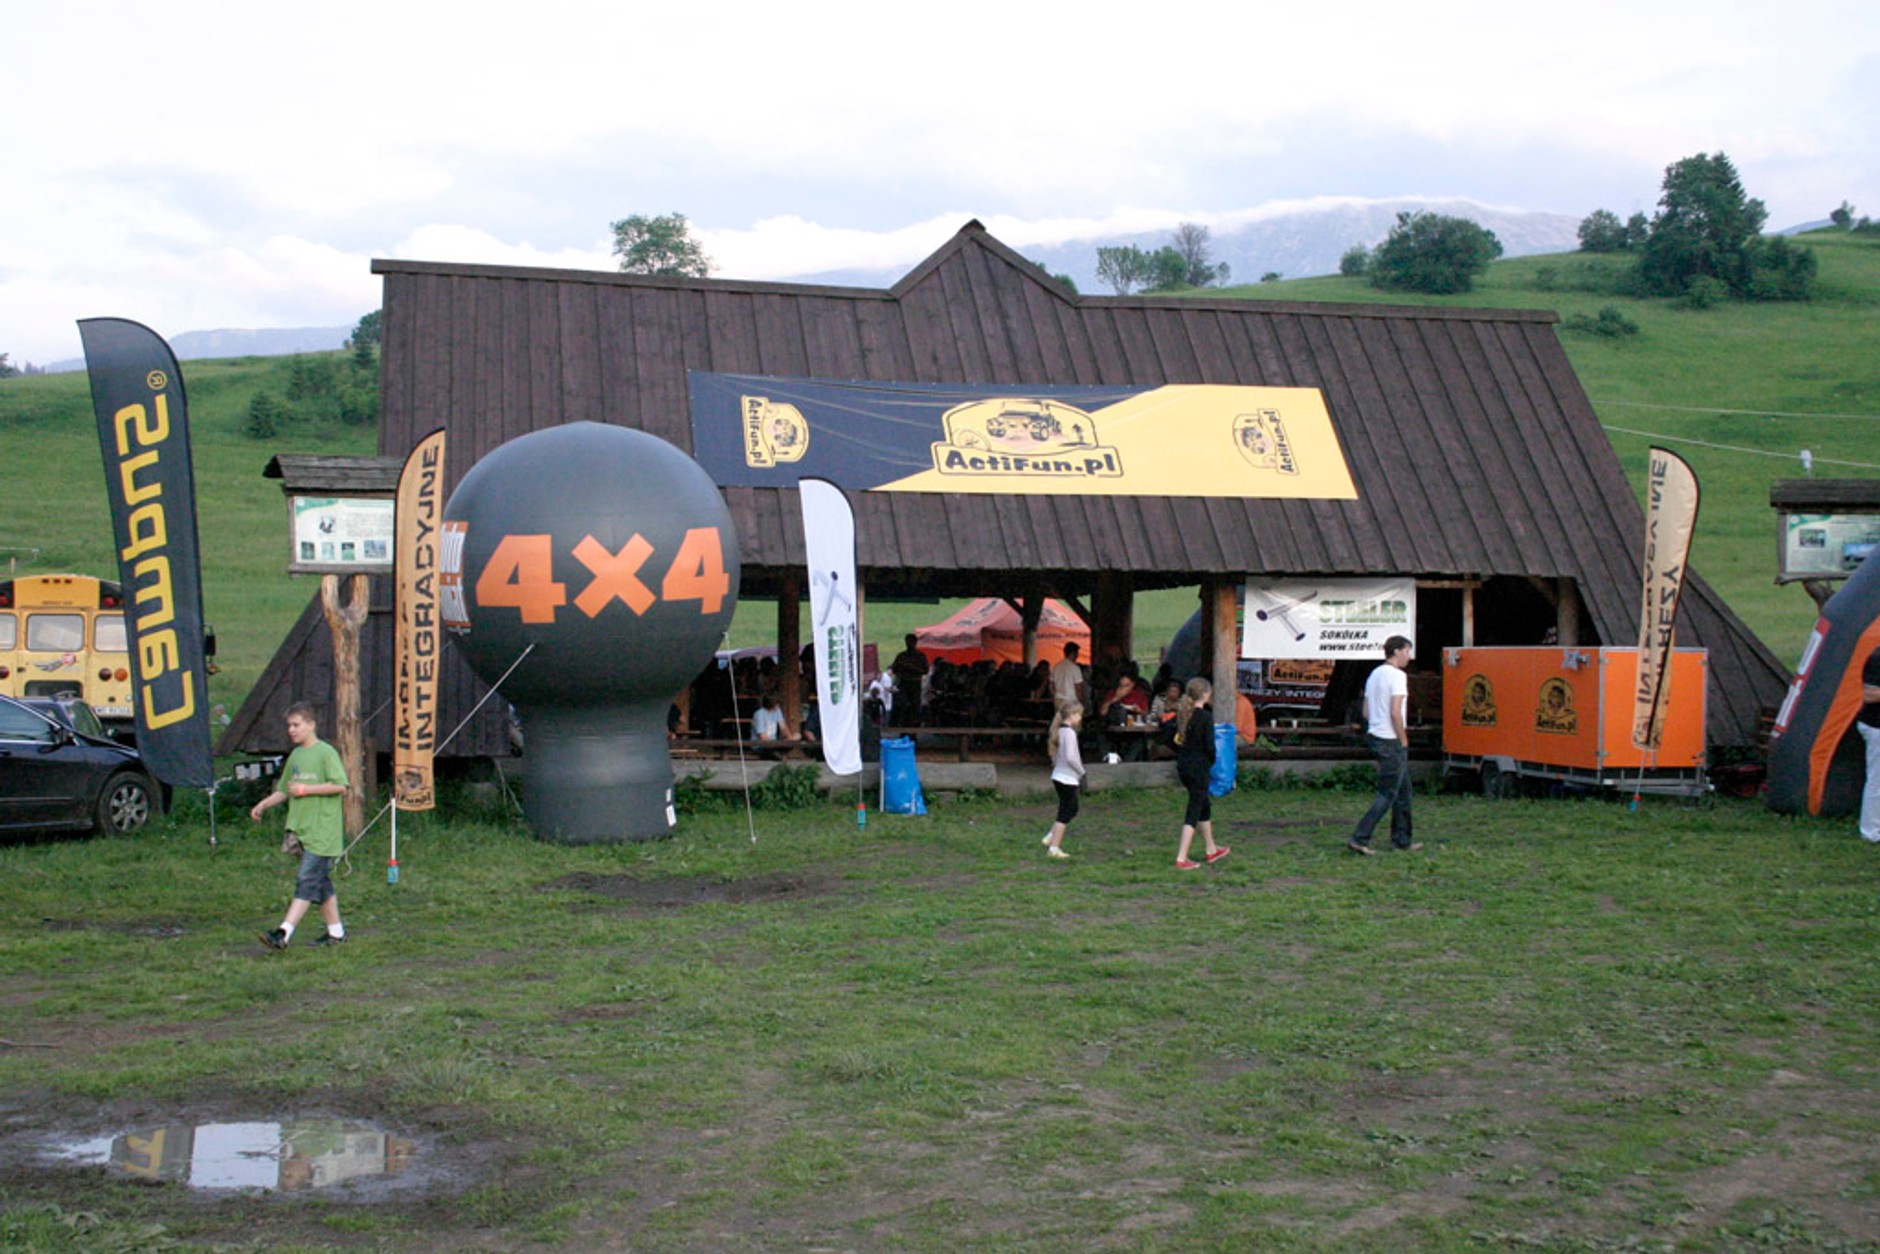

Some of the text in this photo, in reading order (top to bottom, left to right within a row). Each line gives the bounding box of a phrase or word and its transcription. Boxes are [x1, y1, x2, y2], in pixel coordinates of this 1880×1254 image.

[945, 450, 1116, 475] ActiFun.pl
[414, 445, 439, 750] INTEGRACYJNE
[1320, 600, 1408, 623] STEELER
